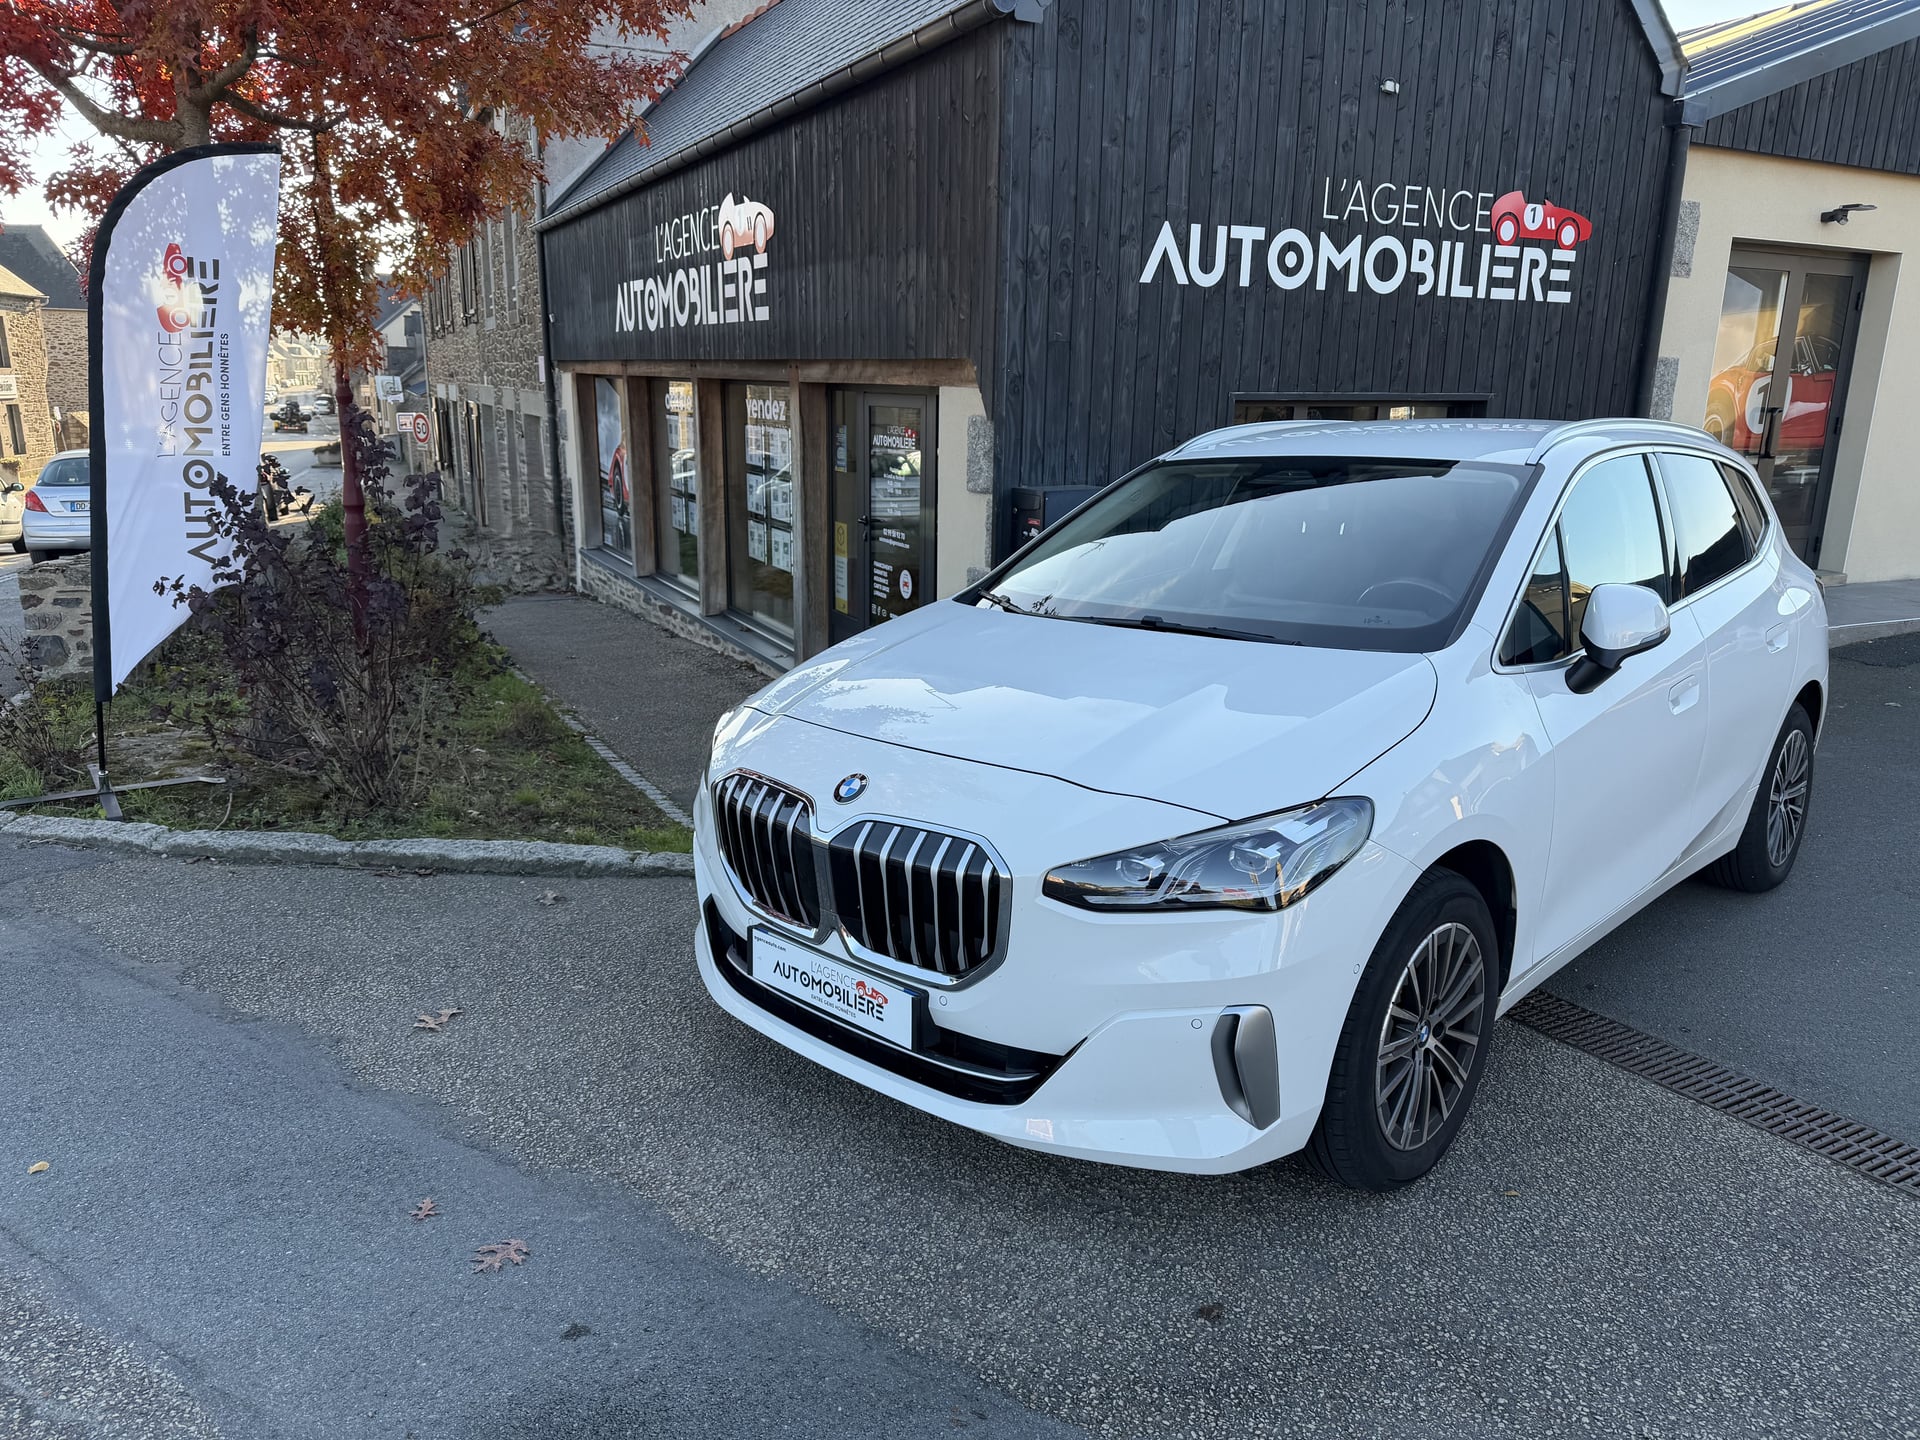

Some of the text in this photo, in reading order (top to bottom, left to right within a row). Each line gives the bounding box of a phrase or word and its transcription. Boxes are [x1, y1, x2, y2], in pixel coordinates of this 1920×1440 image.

[1322, 176, 1494, 232] L'AGENCE
[655, 205, 721, 263] L'AGENCE
[157, 331, 183, 458] L'AGENCE
[217, 333, 230, 457] ENTRE GENS HONNÊTES
[416, 422, 427, 435] 50
[810, 960, 857, 990] L'AGENCE
